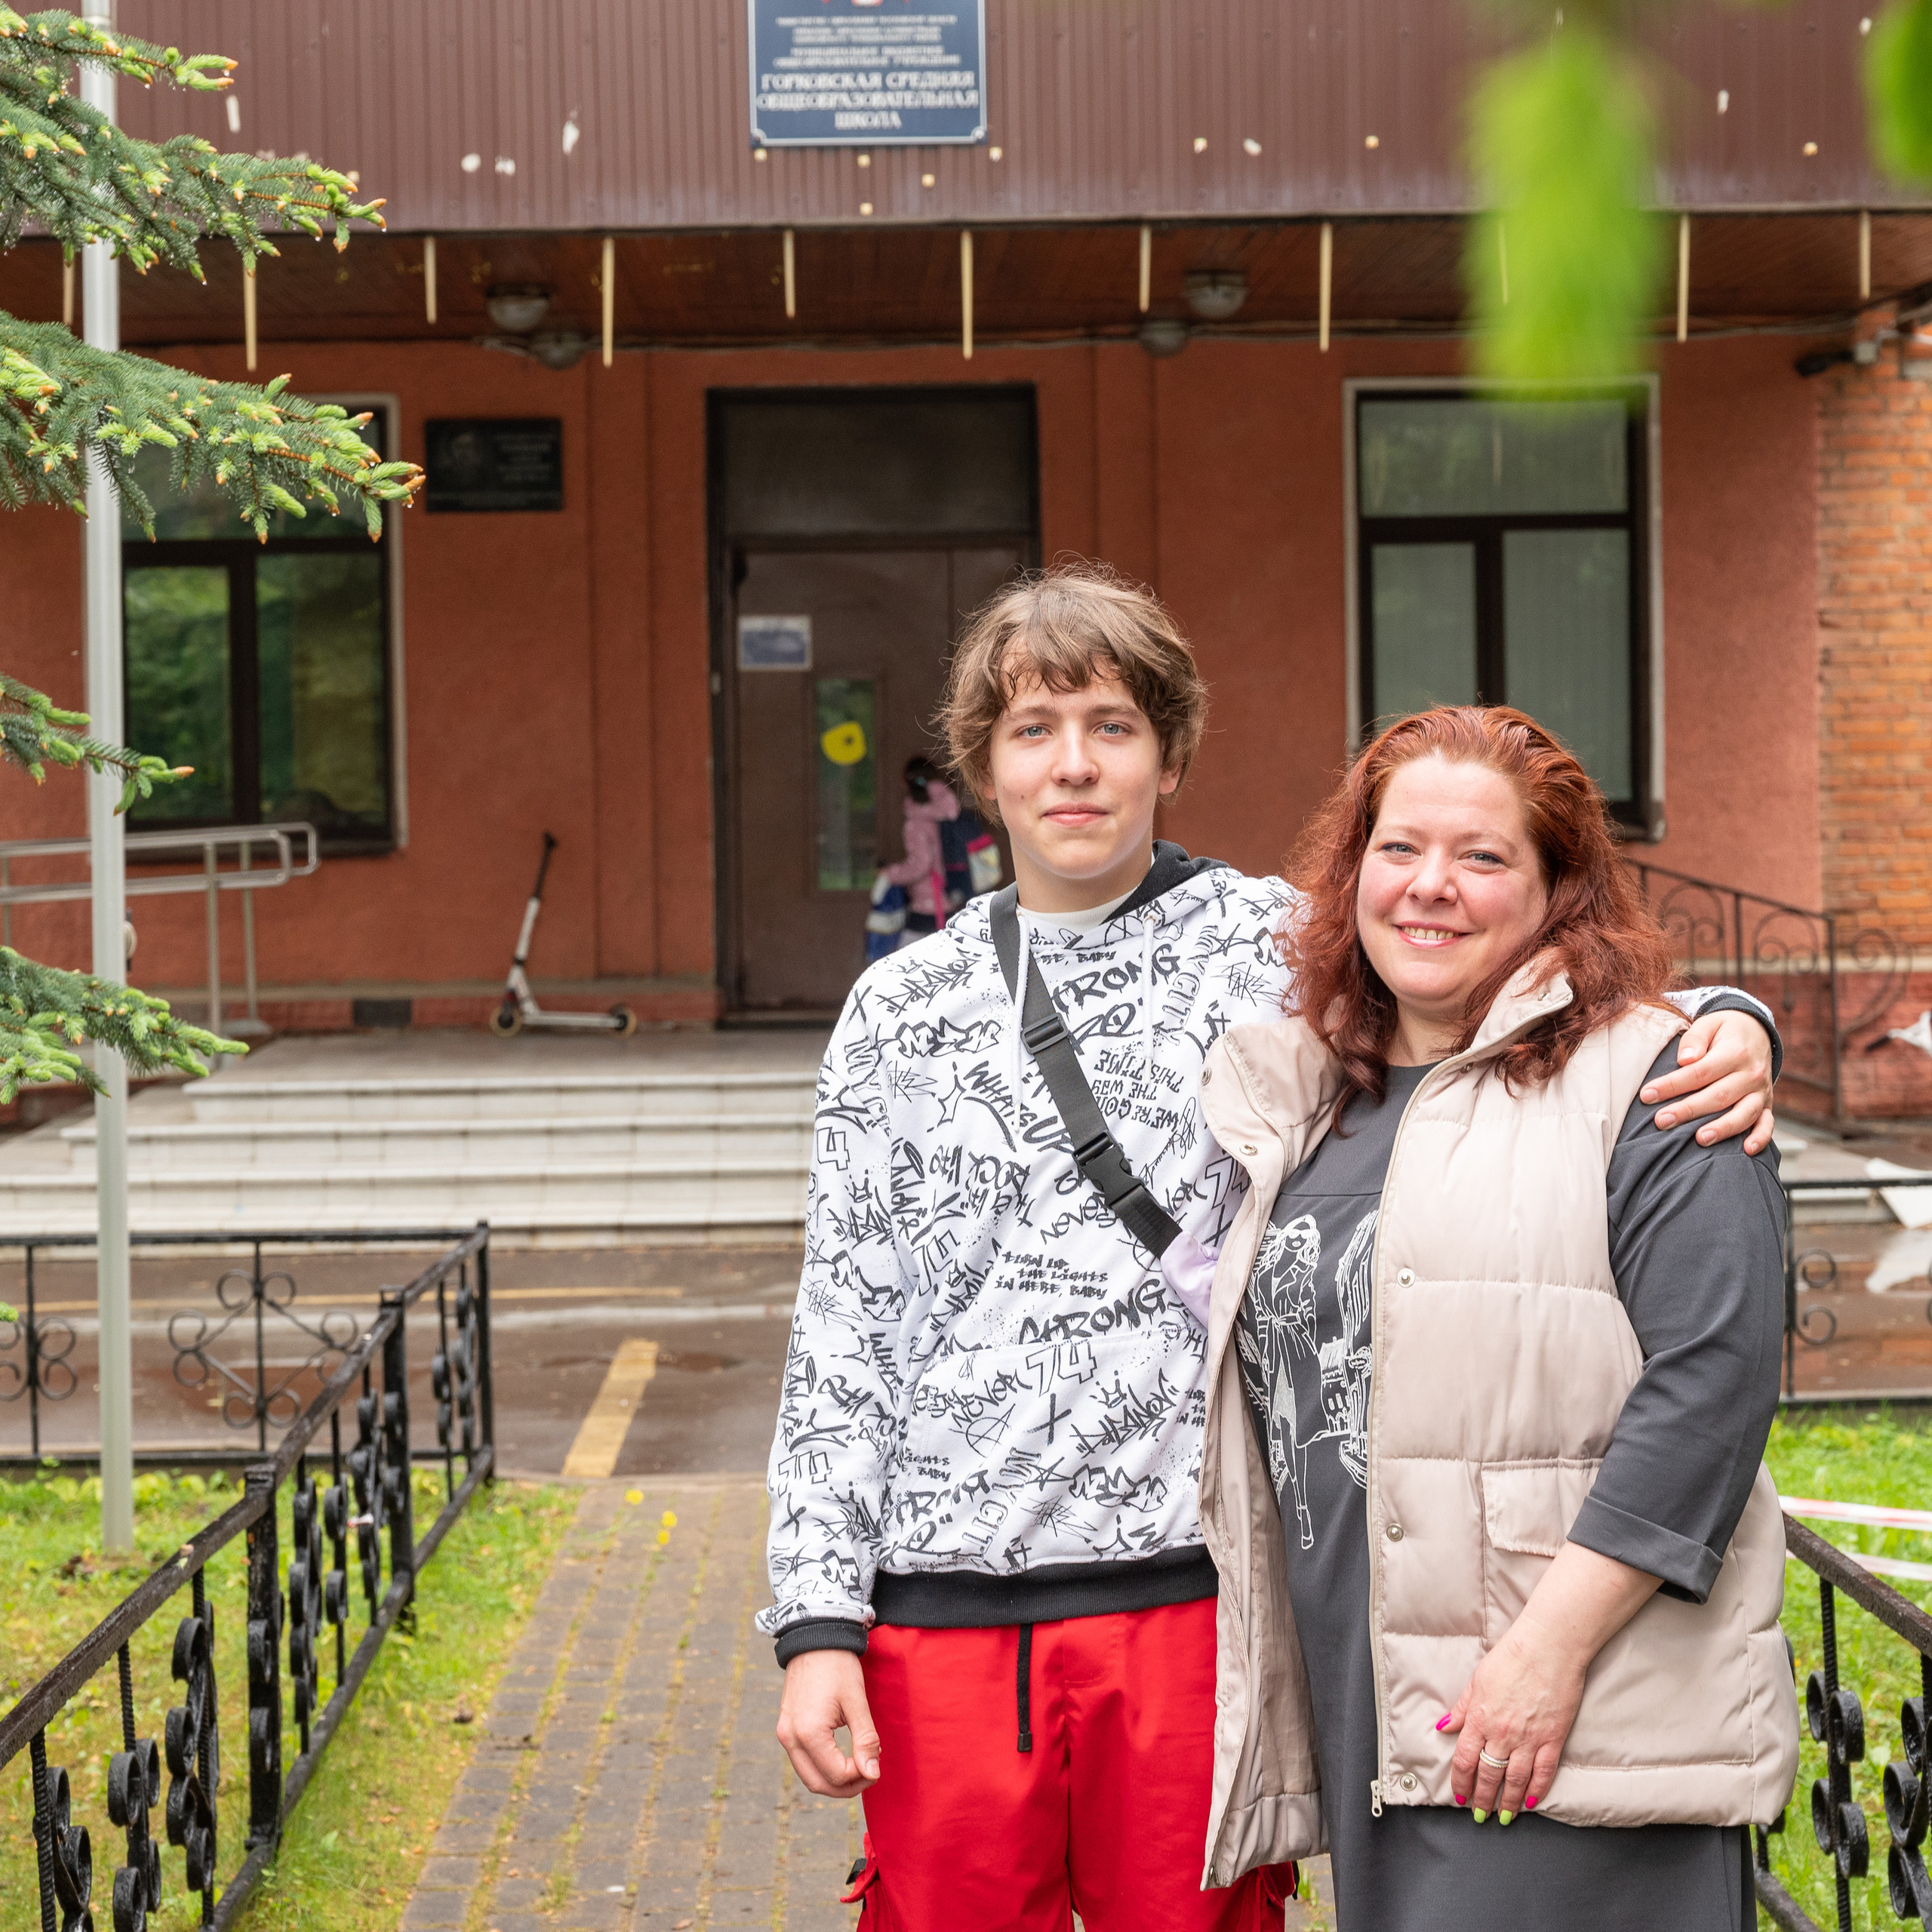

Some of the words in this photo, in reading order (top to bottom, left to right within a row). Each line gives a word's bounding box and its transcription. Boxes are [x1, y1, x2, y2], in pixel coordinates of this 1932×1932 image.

[761, 72, 882, 91] ГОРКОВСКАЯ
[885, 71, 975, 88] СРЕДНЯЯ
[756, 90, 980, 110] ОБЩЕОБРАЗОВАТЕЛЬНАЯ
[834, 112, 902, 129] ШКОЛА
[1001, 1251, 1044, 1269] TURN
[1047, 1258, 1069, 1270] UP
[1017, 1268, 1048, 1279] THE
[1051, 1268, 1109, 1282] LIGHTS
[995, 1275, 1015, 1291] IN
[1018, 1279, 1062, 1297] HERE,
[1069, 1285, 1108, 1300] BABY
[1026, 1340, 1097, 1396] 74
